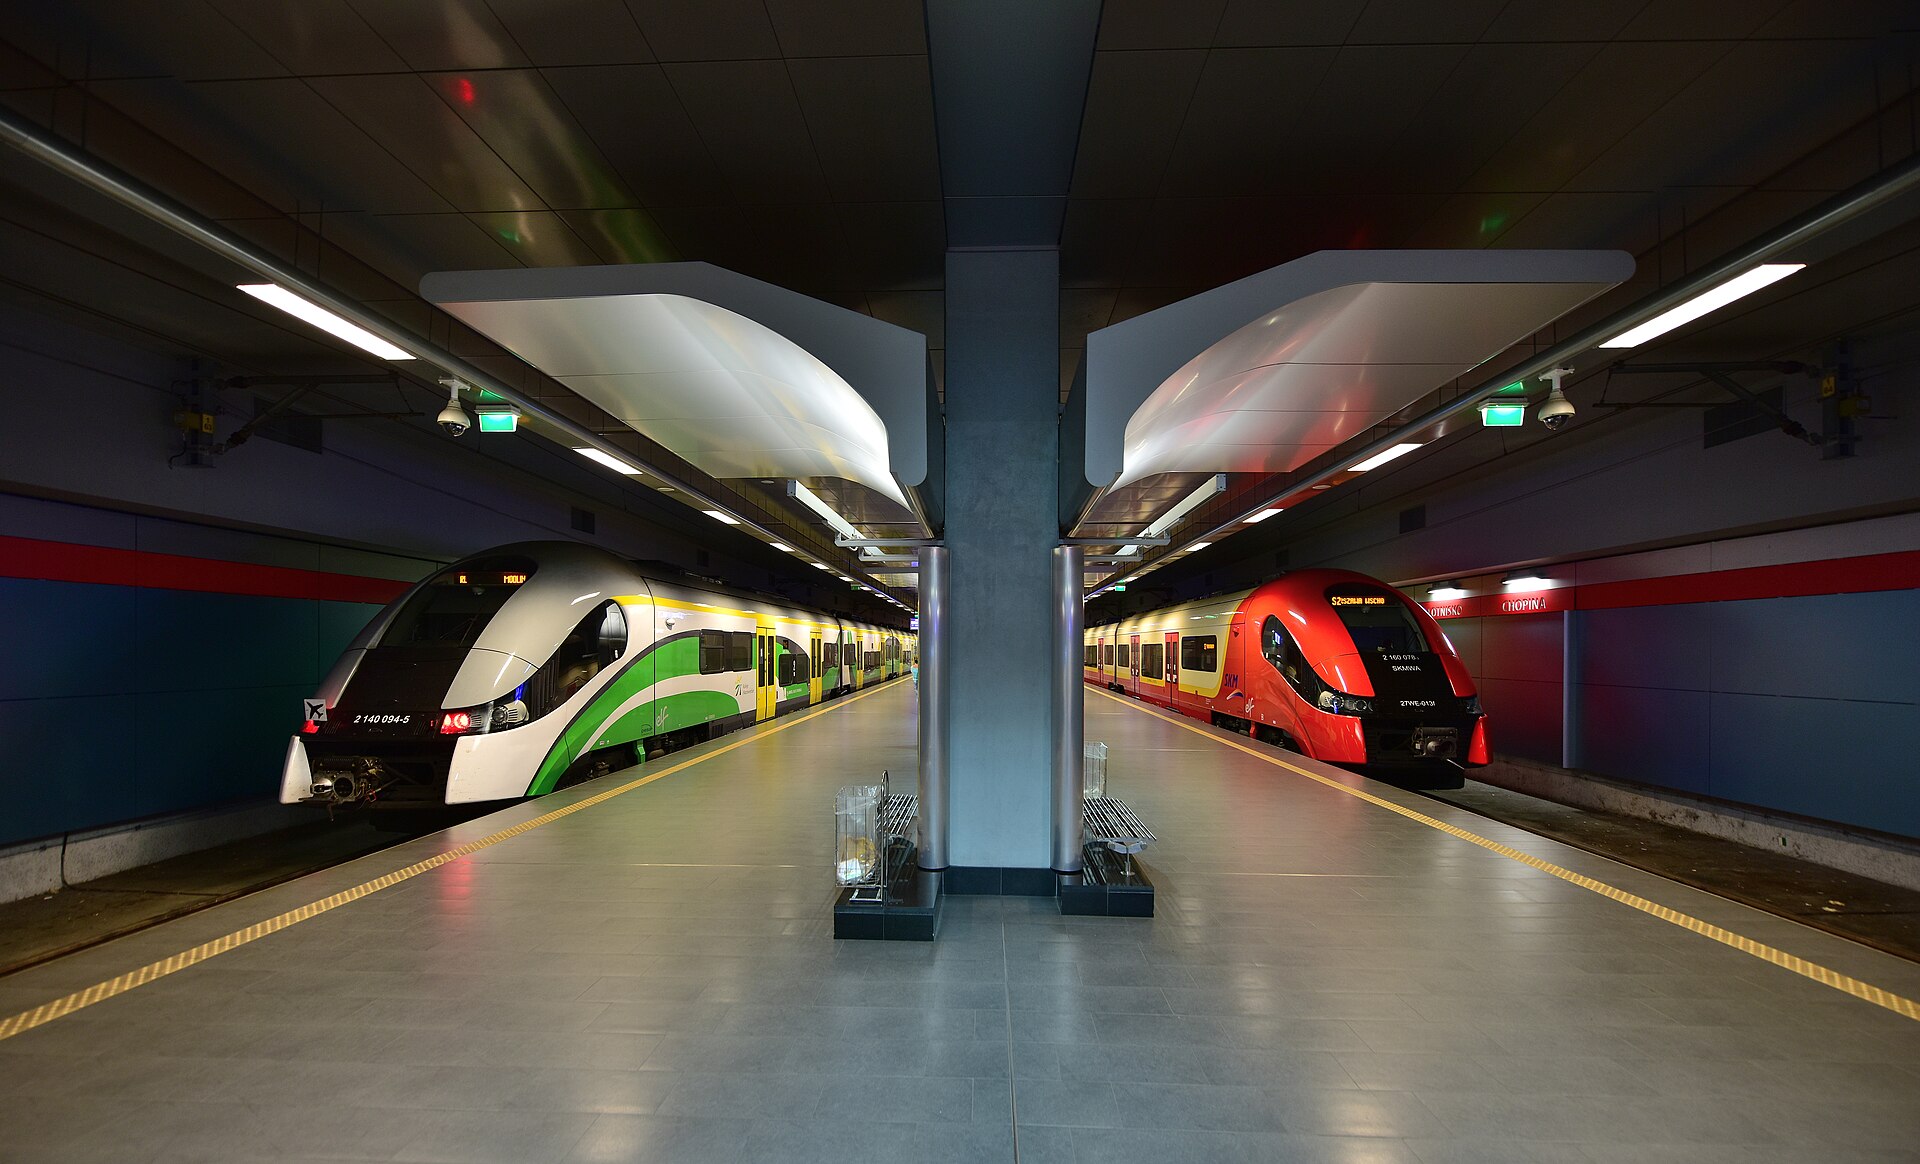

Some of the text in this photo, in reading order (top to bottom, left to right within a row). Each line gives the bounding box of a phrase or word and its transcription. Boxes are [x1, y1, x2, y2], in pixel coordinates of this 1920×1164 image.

[1331, 596, 1342, 606] S2
[1502, 597, 1547, 612] CHOPINA
[1224, 673, 1239, 689] SKM
[1245, 697, 1255, 718] elf
[353, 714, 411, 724] 2 140 094-5
[655, 705, 669, 731] elf
